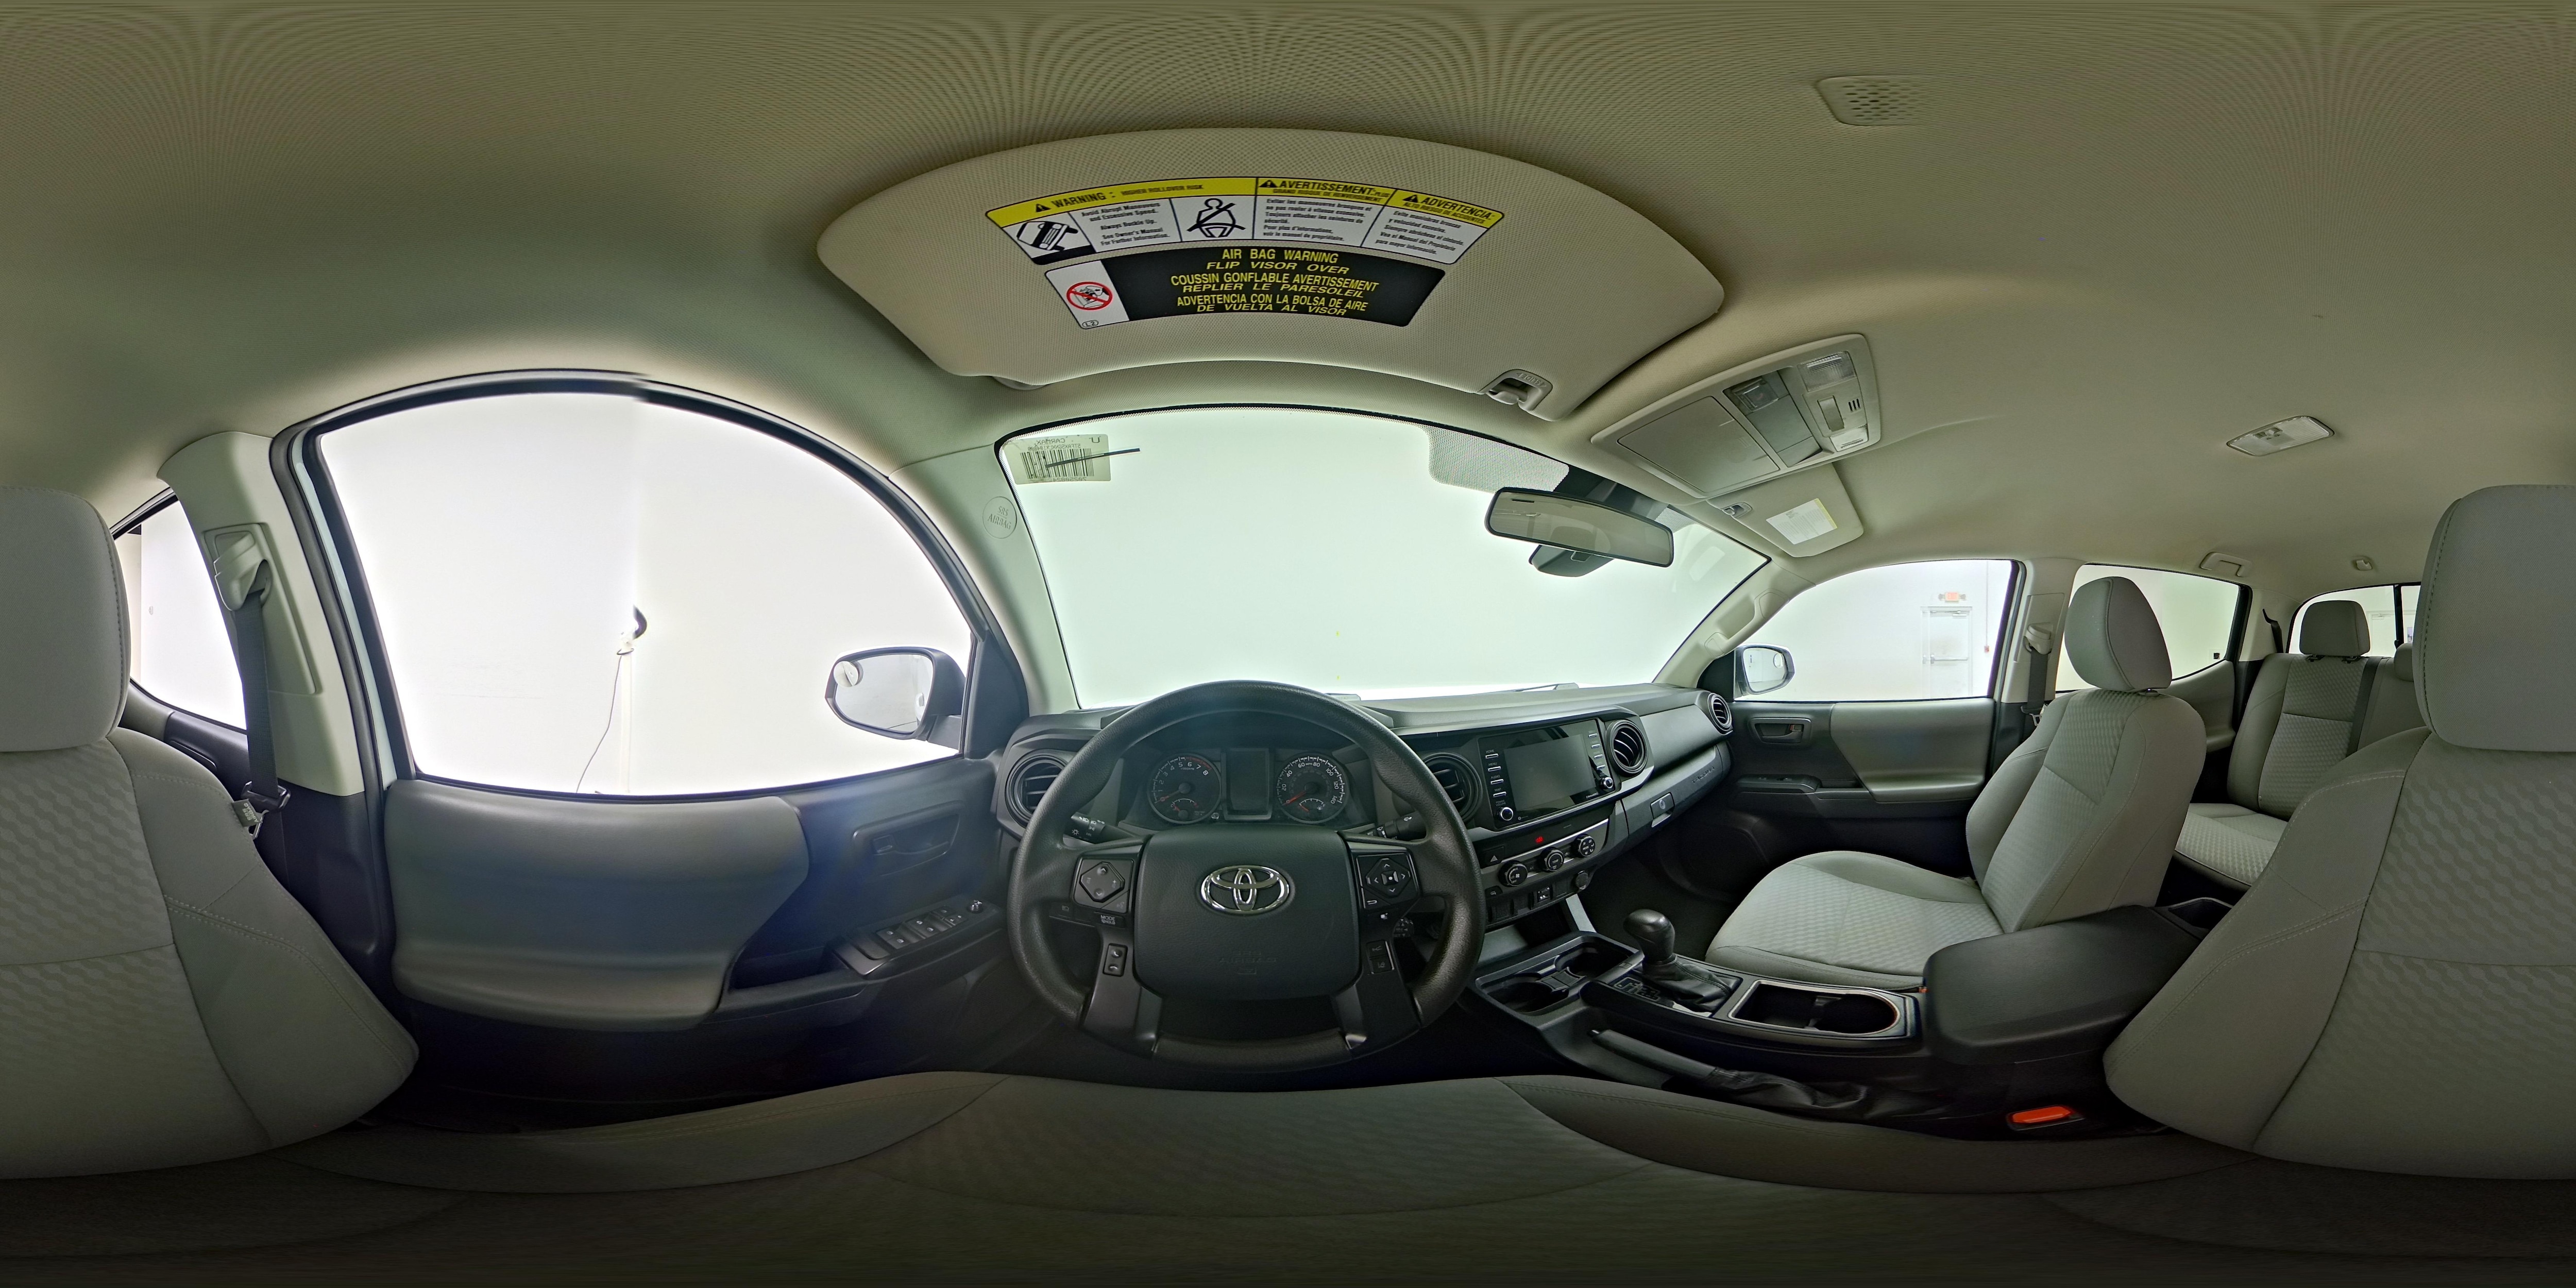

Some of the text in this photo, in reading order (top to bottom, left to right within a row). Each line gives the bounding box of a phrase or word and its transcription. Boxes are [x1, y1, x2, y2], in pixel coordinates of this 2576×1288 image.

[1051, 192, 1106, 208] WARNING
[1149, 185, 1184, 194] ROLLOVER
[1333, 192, 1382, 202] RENVERSEMENT
[1420, 205, 1443, 213] RIESGO
[1451, 211, 1485, 224] ACCIDENTES
[1222, 249, 1339, 264] AIR BAG WARNING
[1206, 261, 1350, 274] FLIP VISOR OVER
[1171, 272, 1379, 292] COUSSIN GONFLABLE AVERTISSEMENT
[1182, 283, 1244, 293] REPLIER
[1280, 284, 1364, 298] PARESOLEIL
[1177, 293, 1368, 311] ADVERTENCIA CON LA BOLSA DE AIRE
[1308, 306, 1347, 316] VISOR
[1521, 374, 1541, 385] SLIDE
[998, 506, 1009, 516] SRS
[988, 513, 1012, 530] AIRBAG
[1326, 768, 1334, 776] 100
[1691, 766, 1715, 784] TACOMA
[244, 803, 259, 822] AIRBAG
